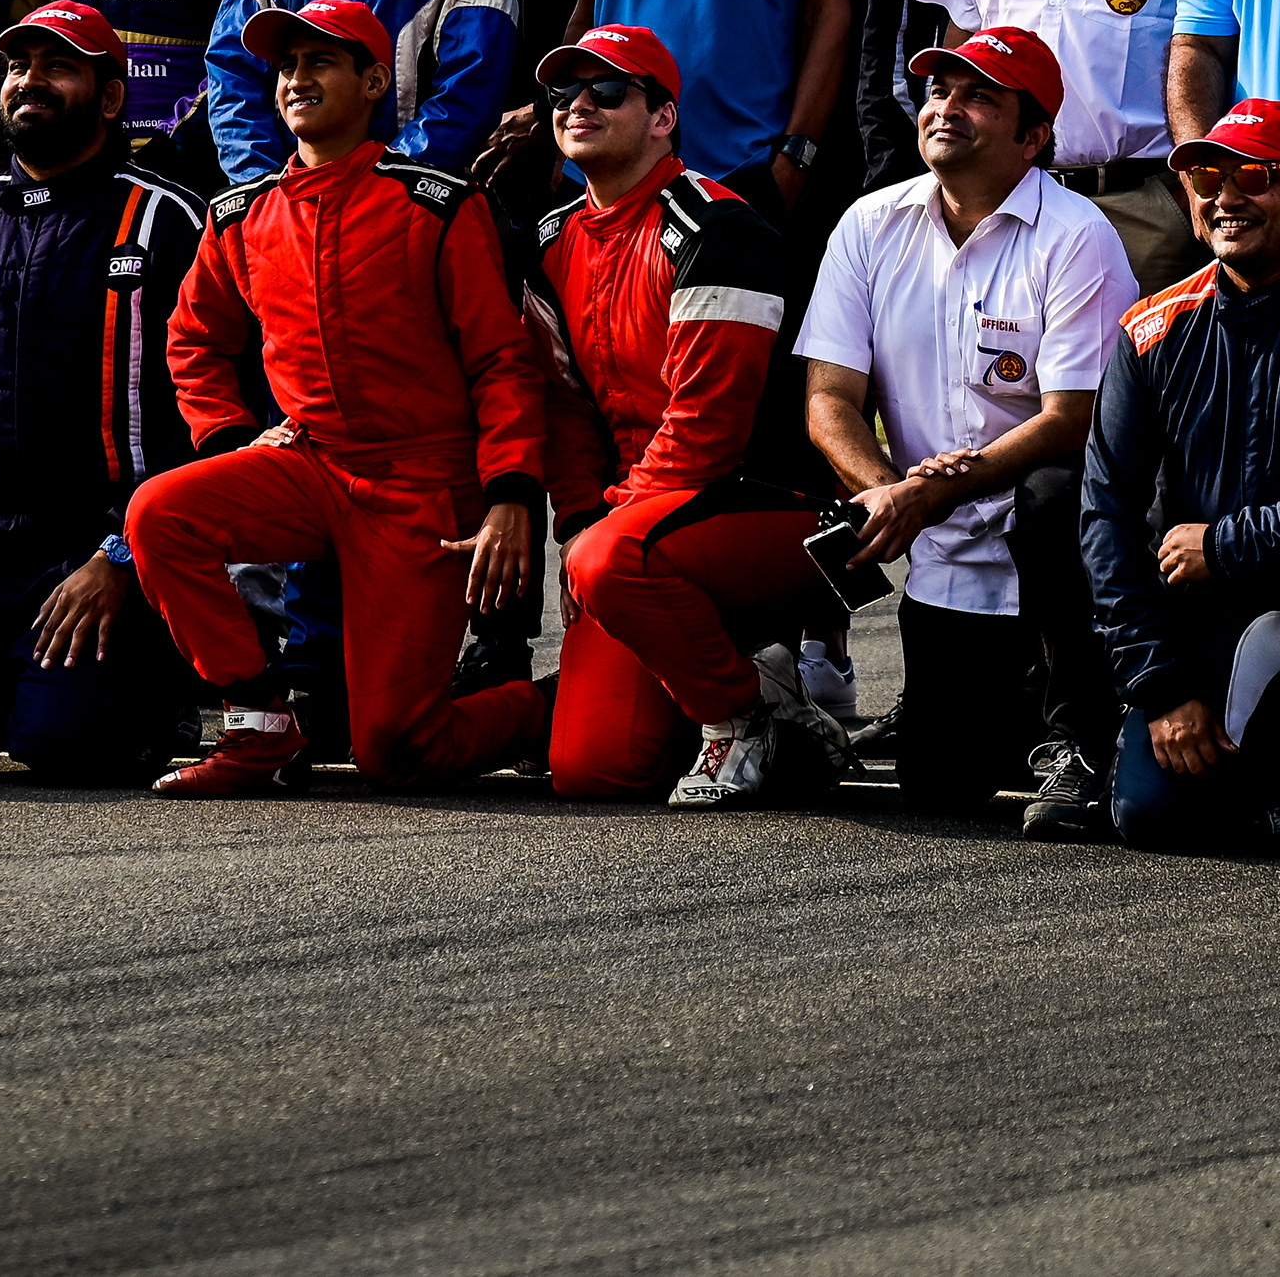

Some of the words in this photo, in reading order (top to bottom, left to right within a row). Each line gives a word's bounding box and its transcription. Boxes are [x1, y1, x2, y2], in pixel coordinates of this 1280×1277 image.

[23, 190, 51, 204] OMP
[416, 180, 450, 200] OMP
[216, 197, 245, 217] OMP
[539, 220, 559, 240] OMP
[662, 226, 682, 249] OMP
[109, 259, 141, 273] OMP
[981, 318, 1020, 333] OFFICIAL
[1133, 316, 1164, 340] OMP
[228, 716, 244, 725] OMP
